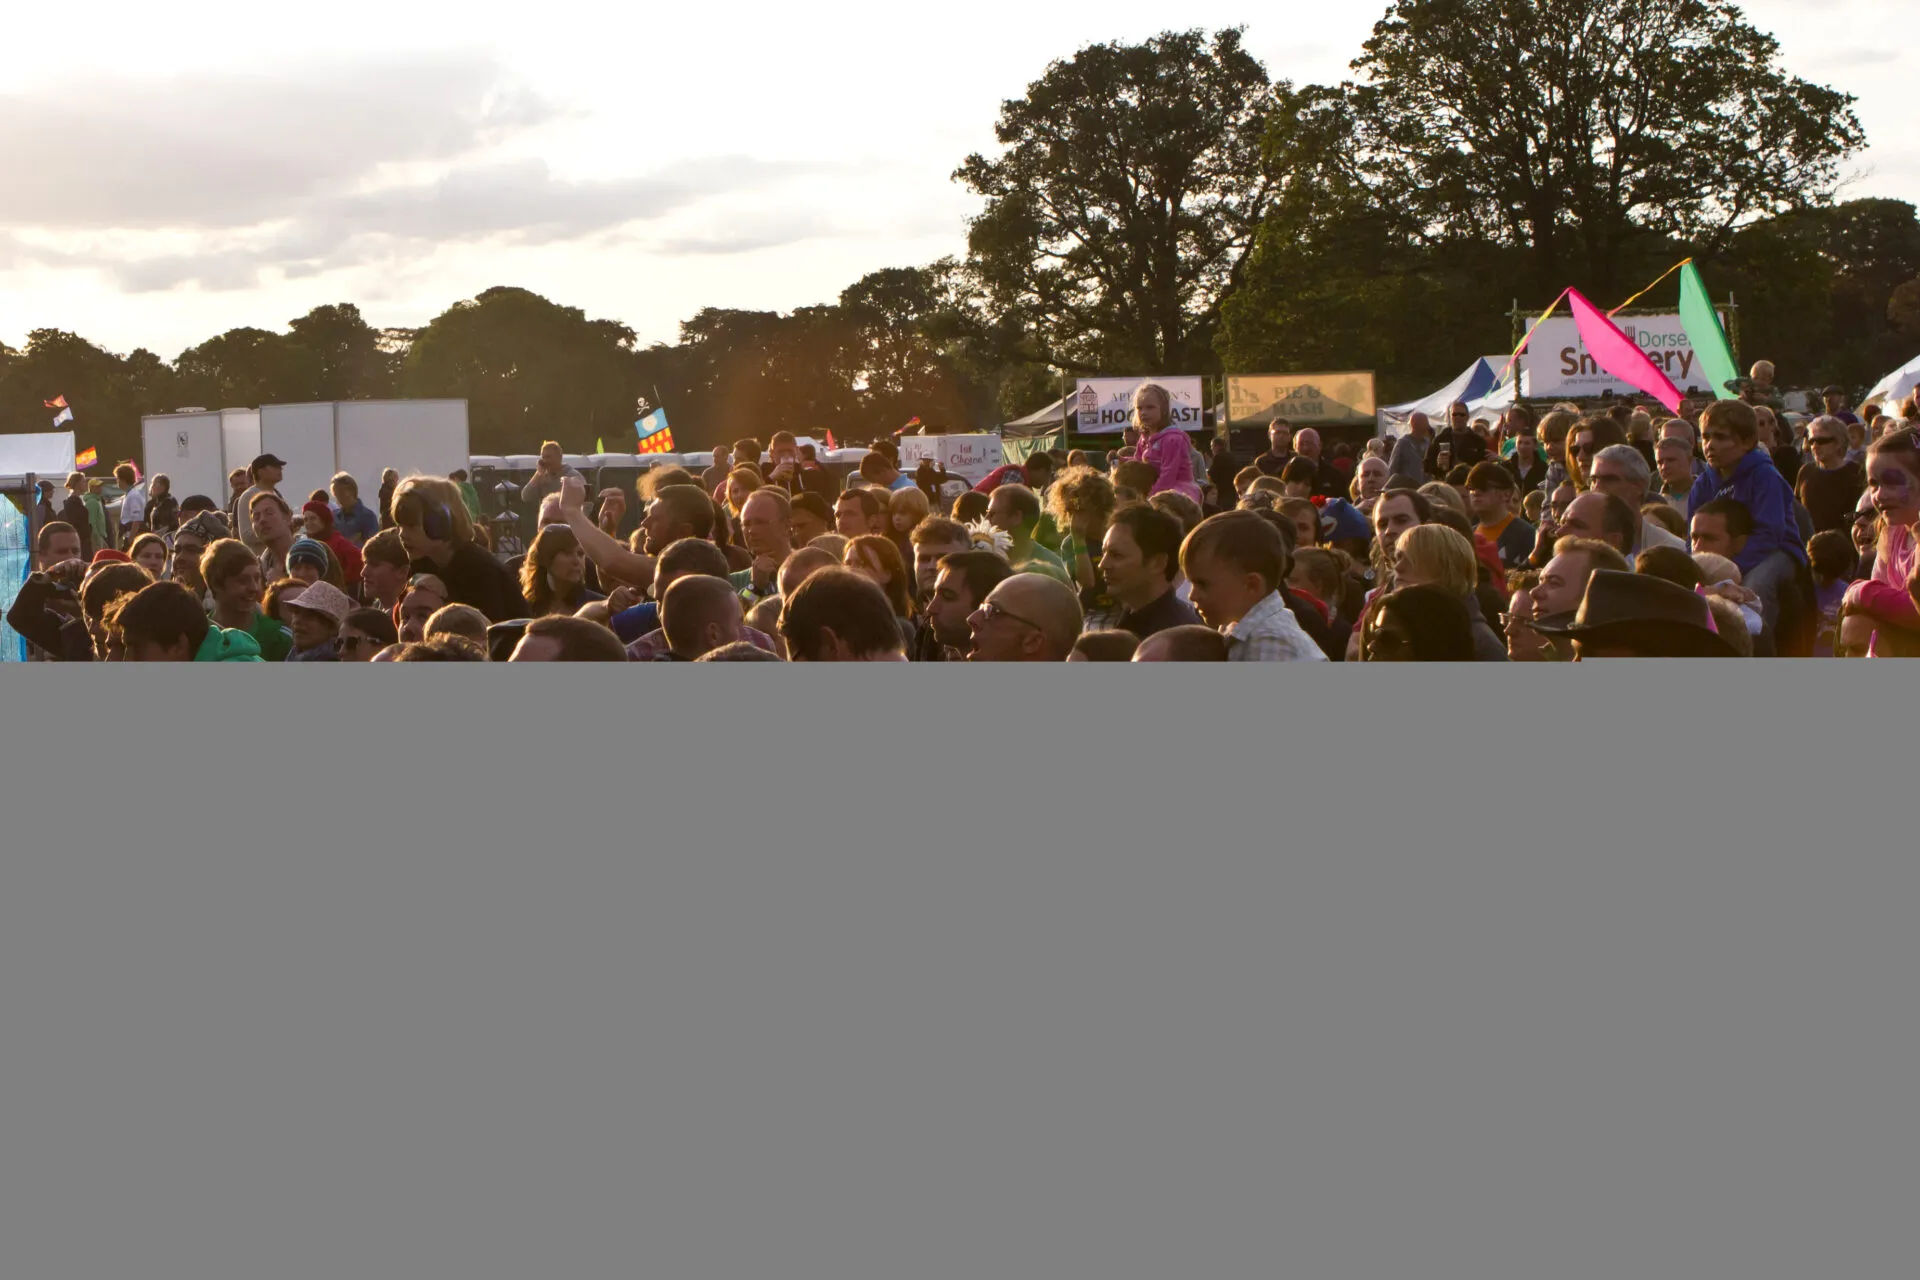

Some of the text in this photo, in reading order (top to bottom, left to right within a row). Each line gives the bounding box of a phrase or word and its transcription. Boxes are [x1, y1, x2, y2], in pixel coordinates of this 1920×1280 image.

[1639, 331, 1692, 348] Dorse
[1560, 347, 1693, 380] Smery
[1273, 386, 1303, 400] PIE
[1273, 402, 1324, 416] MASH
